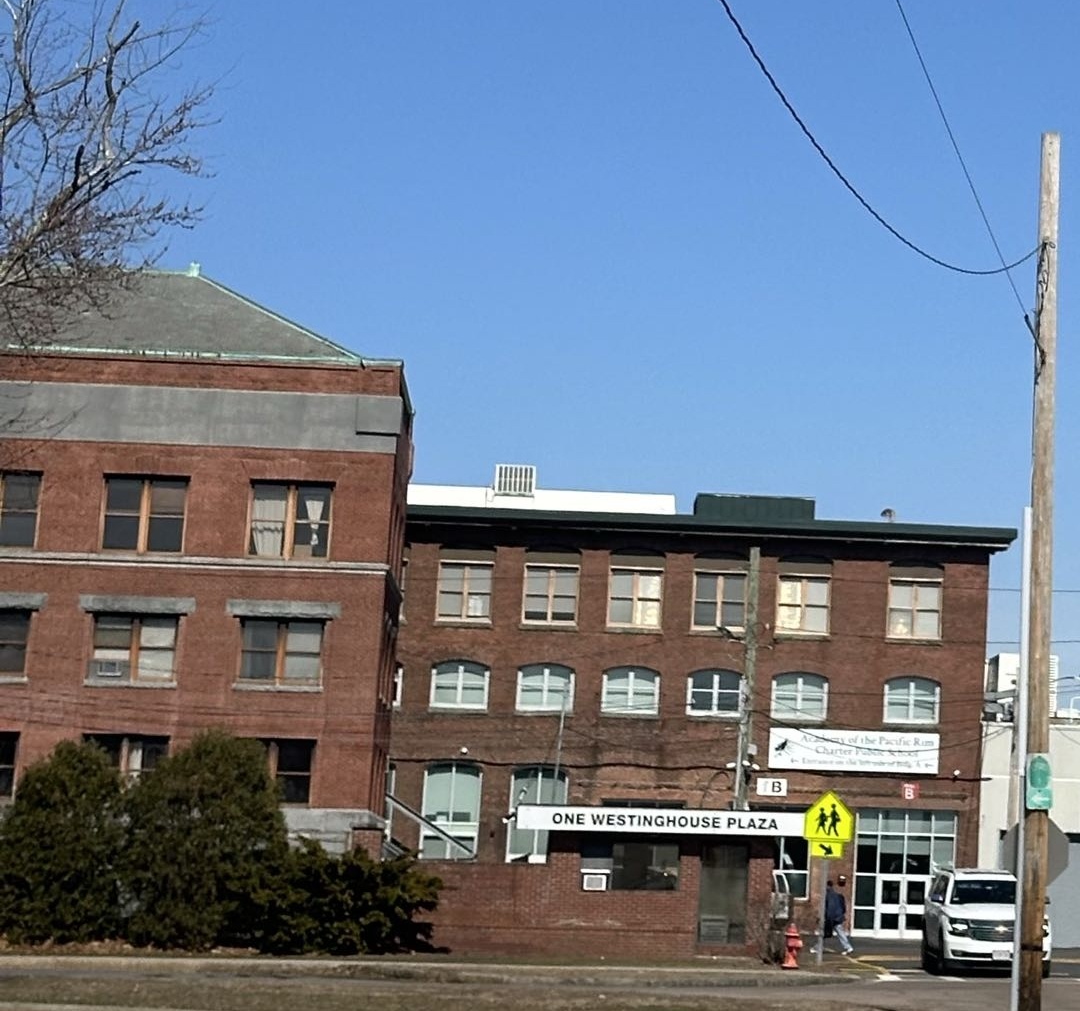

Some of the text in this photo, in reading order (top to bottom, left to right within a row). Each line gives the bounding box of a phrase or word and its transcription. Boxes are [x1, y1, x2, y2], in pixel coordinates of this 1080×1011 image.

[860, 735, 877, 745] the
[879, 736, 911, 746] Pacific
[913, 737, 934, 747] Rim
[815, 745, 853, 755] Charter
[771, 781, 782, 793] B
[904, 788, 914, 800] B
[552, 812, 778, 830] ONE WESTINGHOUSE PLAZA
